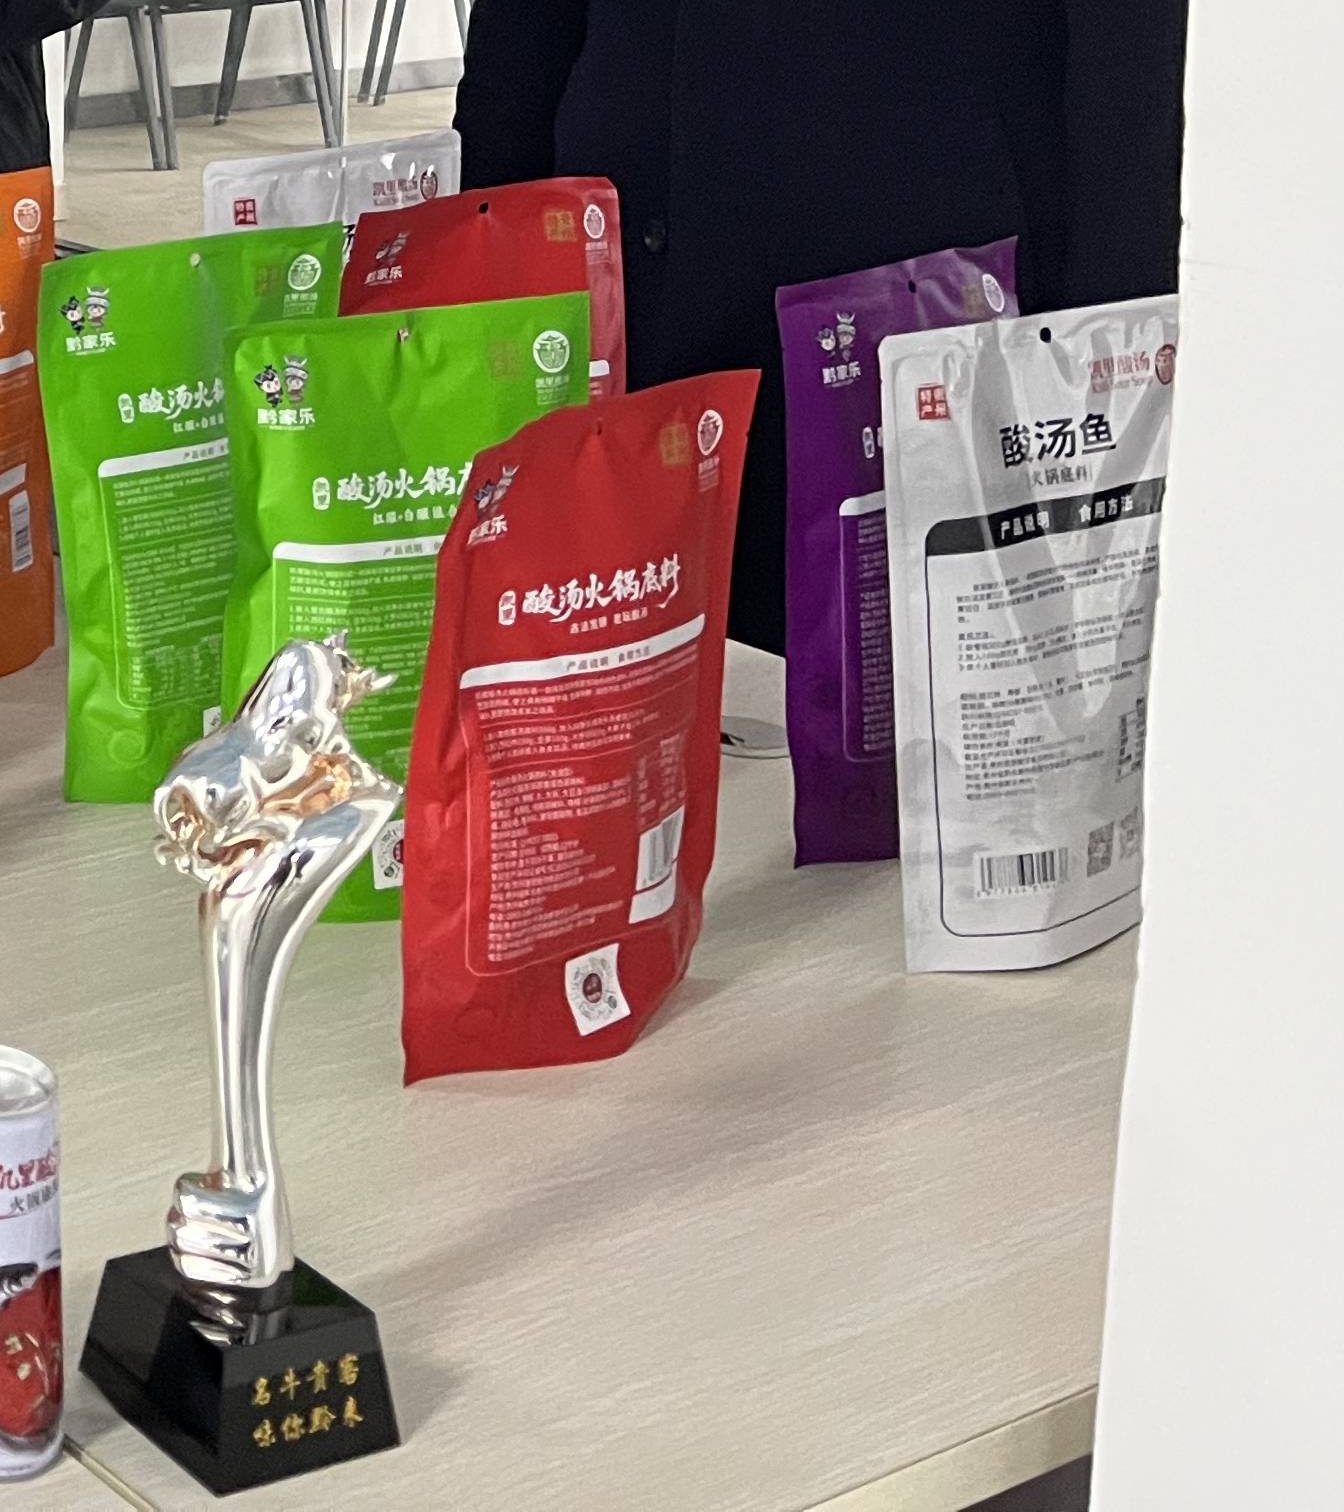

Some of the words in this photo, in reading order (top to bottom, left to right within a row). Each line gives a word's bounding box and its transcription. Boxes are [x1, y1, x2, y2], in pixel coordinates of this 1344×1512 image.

[65, 331, 117, 353] 黔家乐
[822, 361, 861, 383] 黔家乐
[1089, 350, 1151, 379] 凯里酸汤
[257, 407, 316, 426] 黔家乐
[1000, 413, 1116, 469] 酸汤鱼
[1030, 465, 1089, 487] 火锅底料
[1000, 511, 1050, 540] 产品说明
[1078, 494, 1134, 523] 食用方法
[521, 552, 681, 623] 酸汤火锅底料
